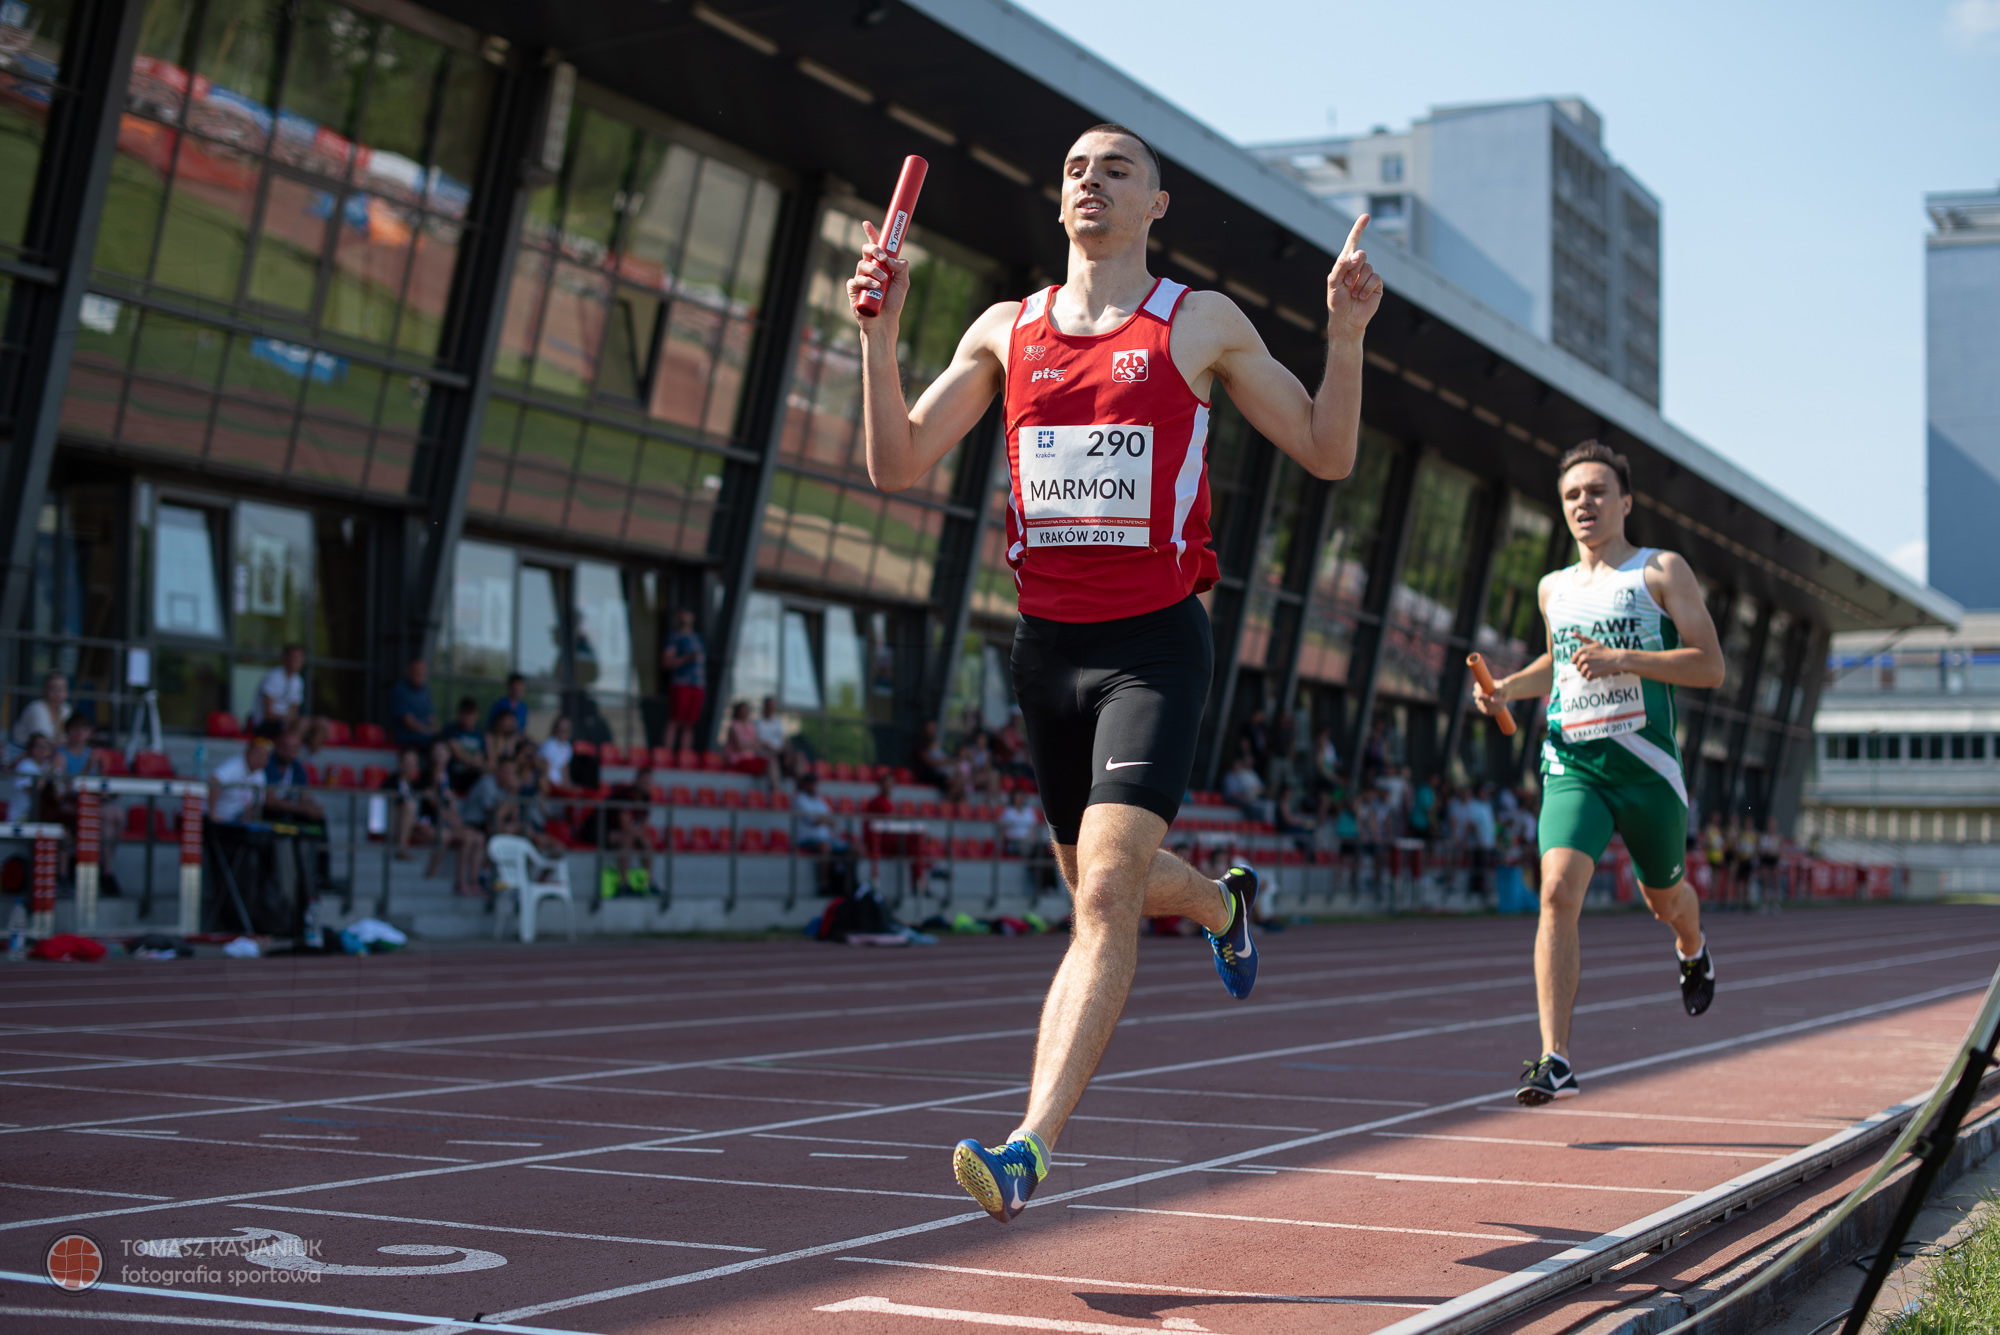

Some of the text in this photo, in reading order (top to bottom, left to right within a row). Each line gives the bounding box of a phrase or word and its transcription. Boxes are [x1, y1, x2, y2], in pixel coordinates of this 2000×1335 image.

[893, 213, 905, 240] polanik
[1086, 430, 1146, 457] 290
[1030, 478, 1136, 502] MARMON
[1040, 527, 1125, 543] KRAKÓW 2019
[1591, 617, 1643, 637] AWF
[1564, 686, 1639, 713] GADOMSKI
[1573, 724, 1609, 739] KRAKÓW
[1611, 720, 1633, 733] 2019
